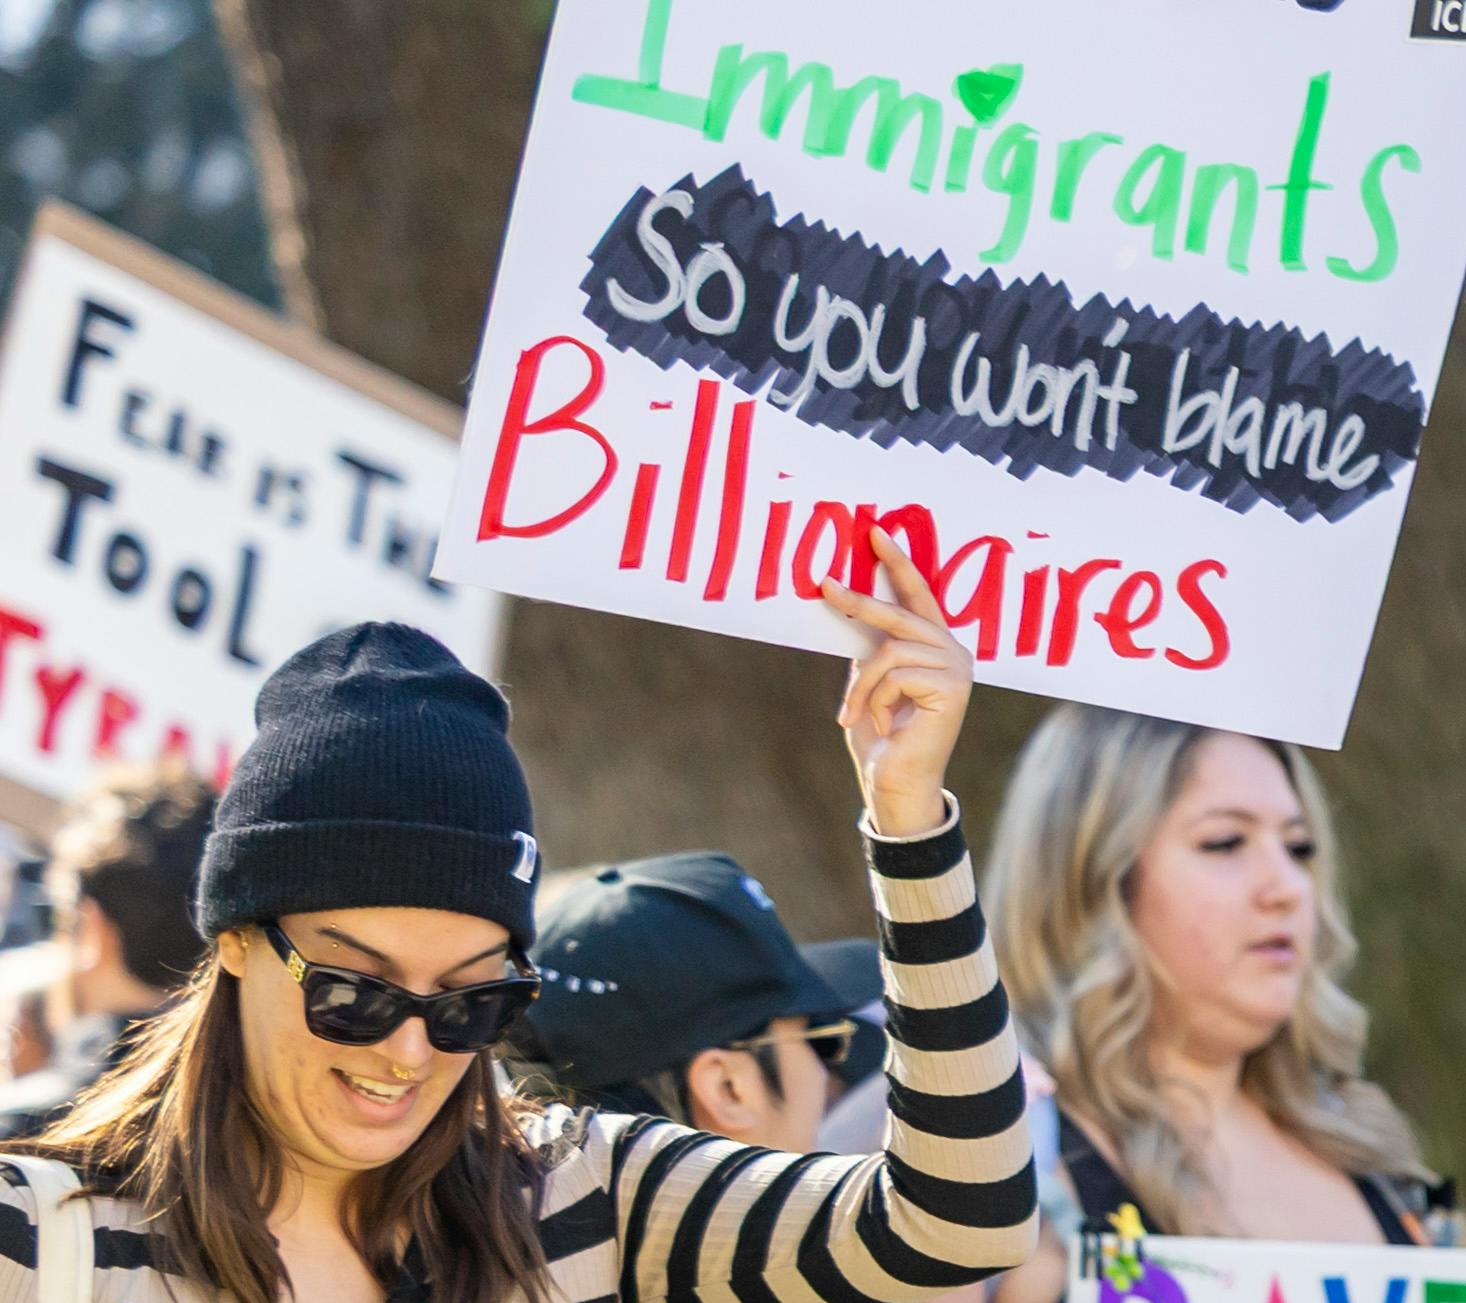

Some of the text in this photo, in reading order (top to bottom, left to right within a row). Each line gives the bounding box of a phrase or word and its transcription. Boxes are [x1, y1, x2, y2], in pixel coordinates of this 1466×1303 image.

[570, 0, 1422, 283] Immigrants
[605, 189, 1382, 490] So you won't blame
[476, 334, 1232, 671] Billionaires
